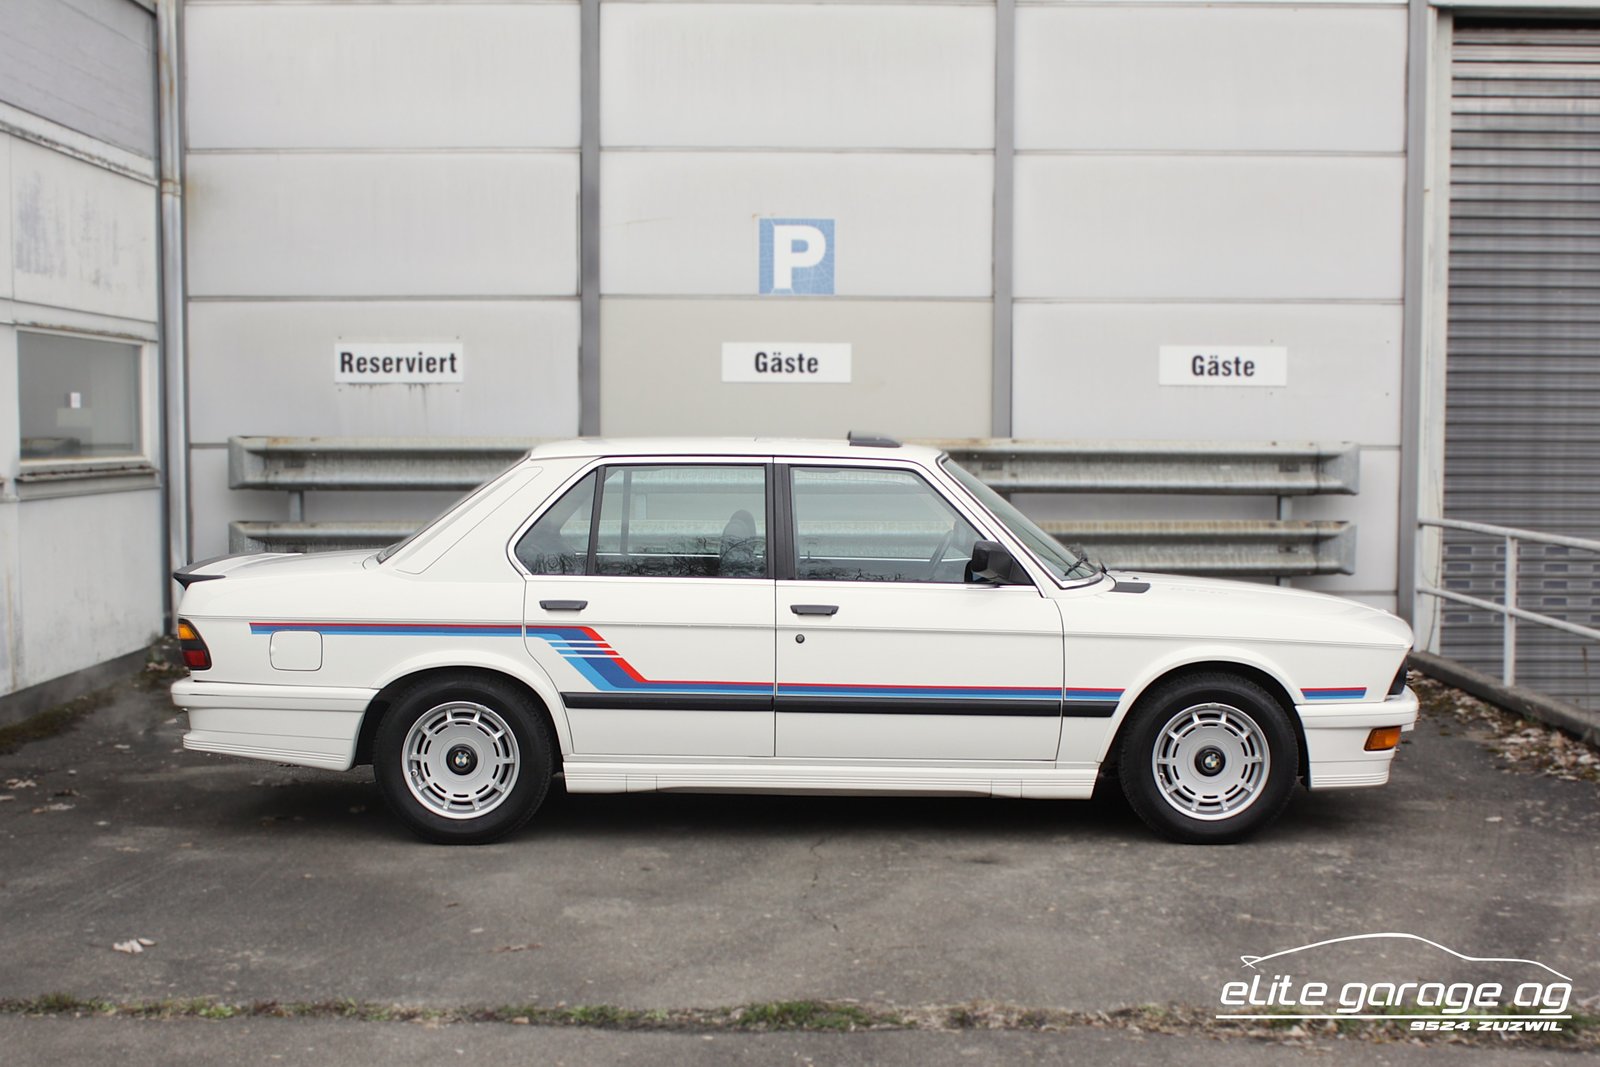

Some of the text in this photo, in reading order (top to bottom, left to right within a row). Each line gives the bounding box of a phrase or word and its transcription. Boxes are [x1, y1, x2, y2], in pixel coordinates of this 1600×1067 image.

[773, 224, 827, 291] P
[340, 351, 457, 374] Reserviert
[754, 351, 818, 374] Gäste
[1191, 355, 1255, 377] Gäste
